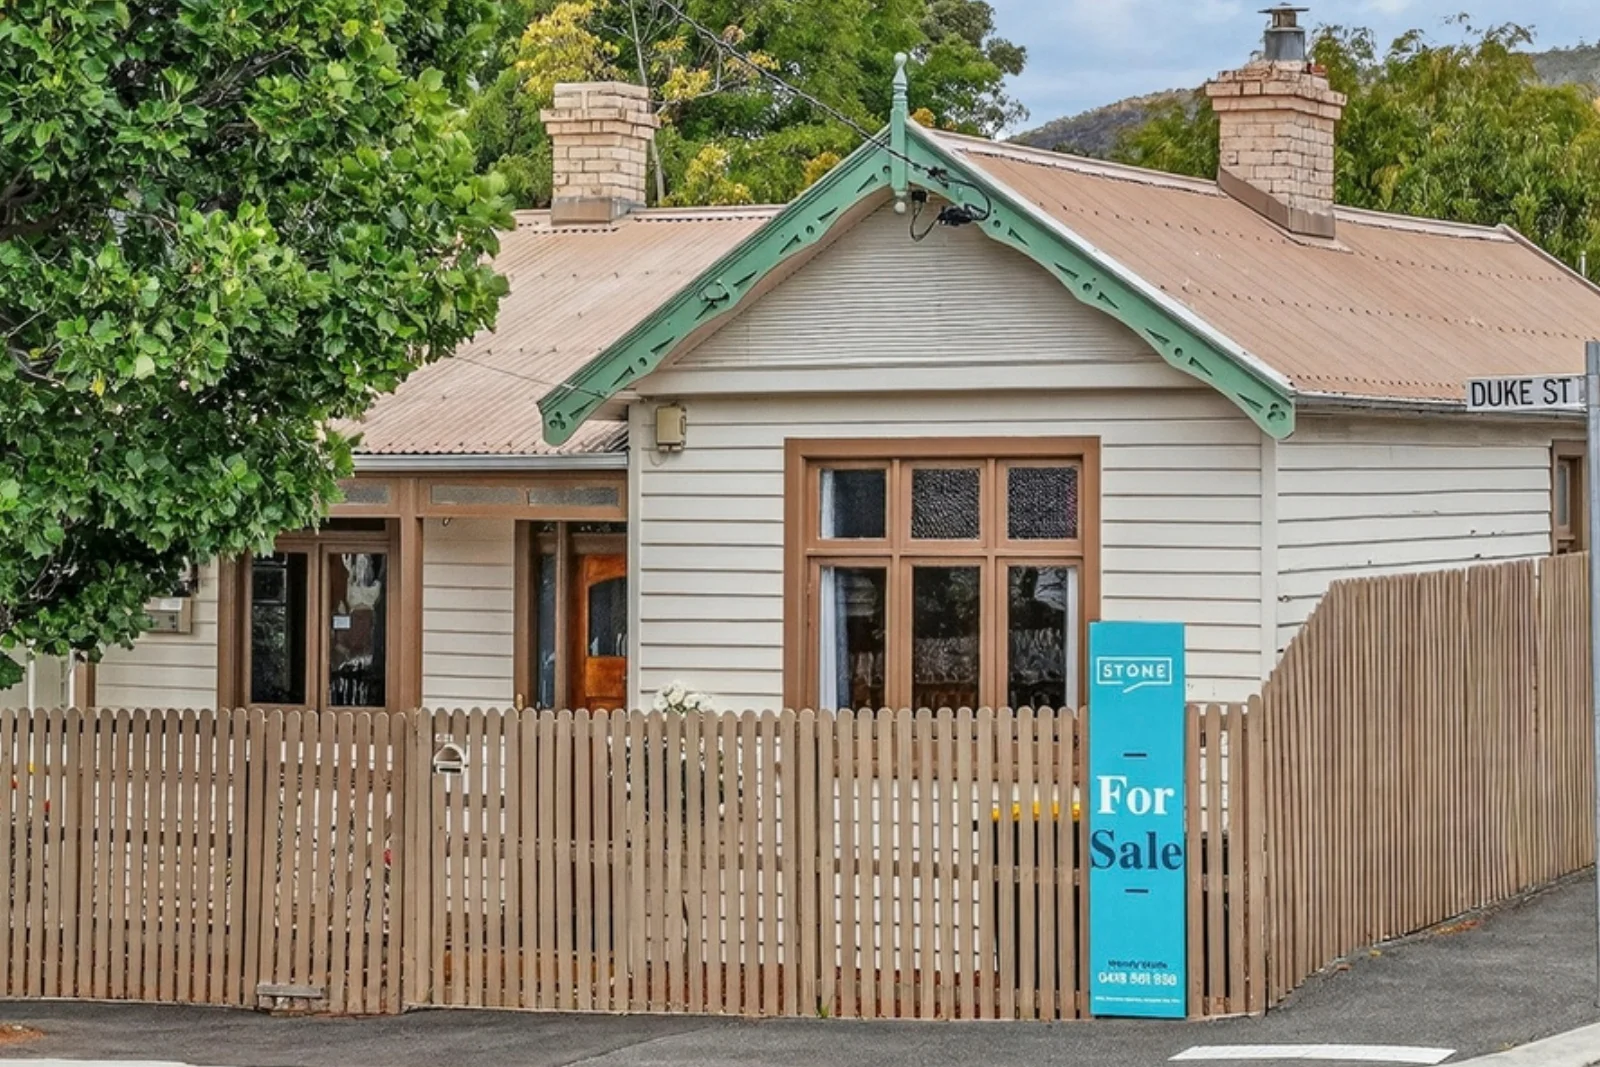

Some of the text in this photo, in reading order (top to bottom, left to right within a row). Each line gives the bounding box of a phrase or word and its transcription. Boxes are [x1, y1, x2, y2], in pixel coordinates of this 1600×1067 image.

[1471, 378, 1571, 407] DUKE ST
[1103, 663, 1166, 678] STONE
[1096, 775, 1176, 815] For
[1090, 829, 1184, 870] Sale
